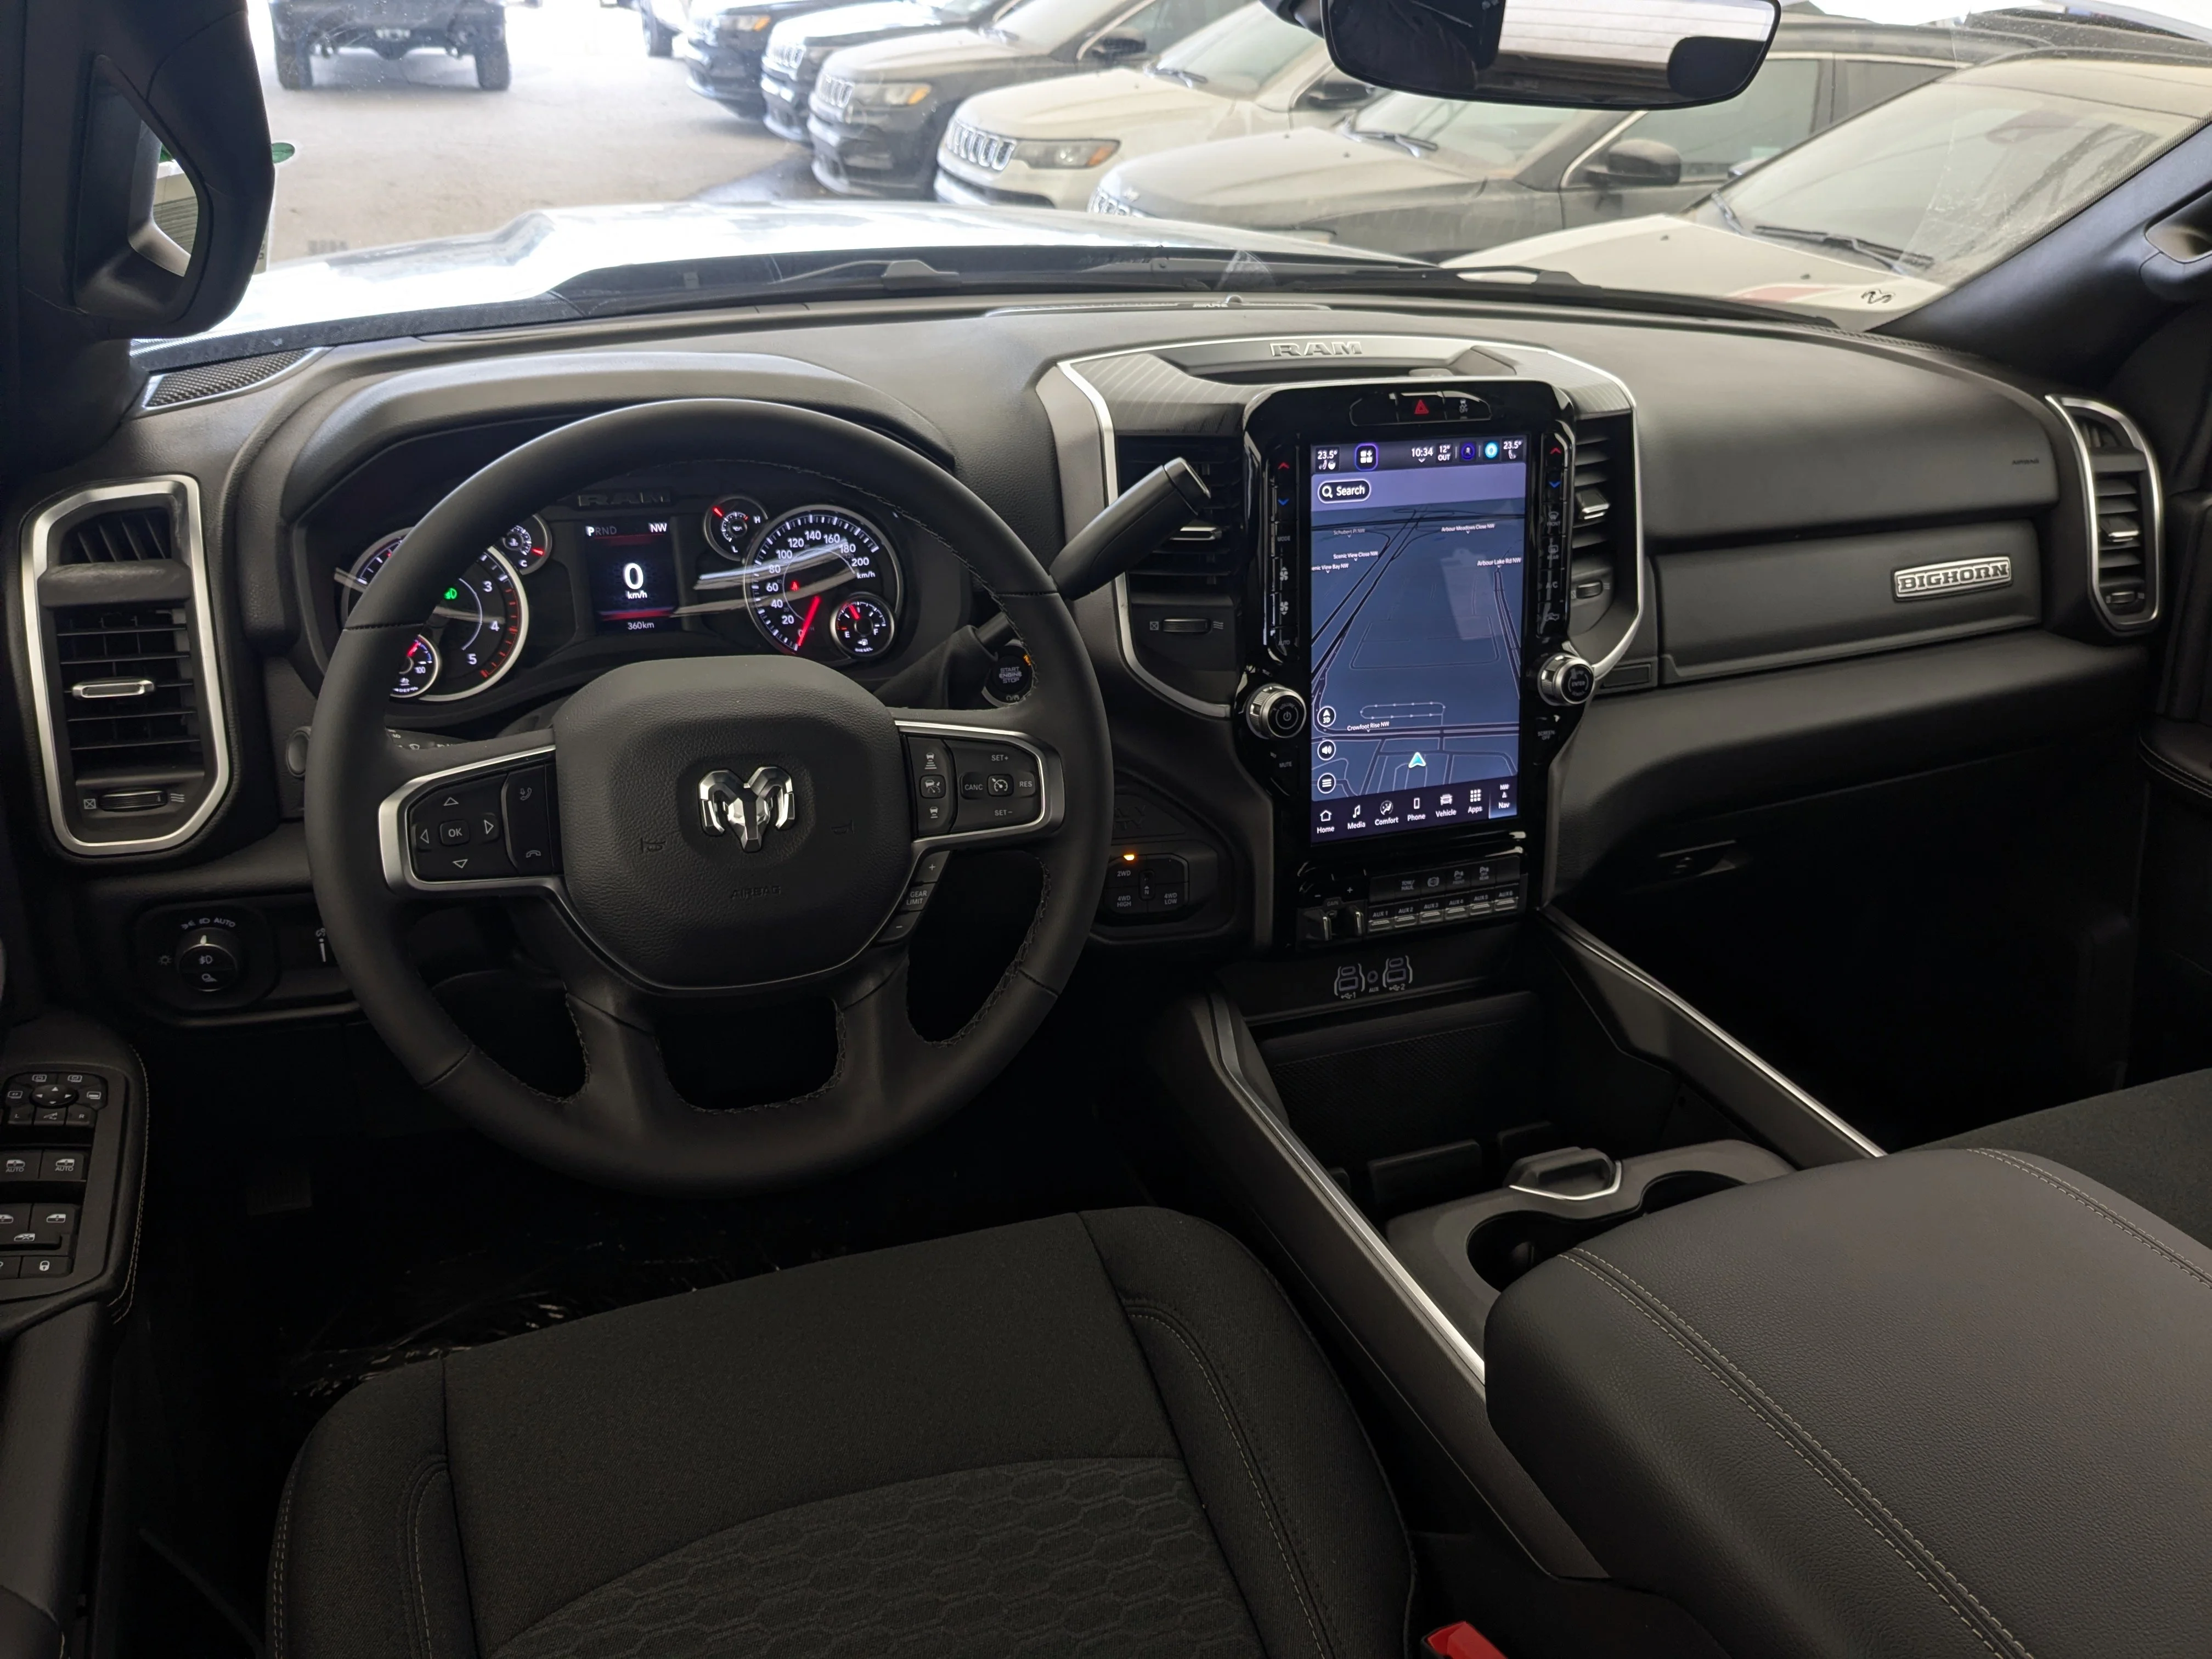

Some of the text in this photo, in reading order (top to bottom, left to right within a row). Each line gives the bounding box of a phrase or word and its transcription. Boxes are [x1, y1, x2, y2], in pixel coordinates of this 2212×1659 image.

[1270, 341, 1362, 357] RAM
[1440, 444, 1451, 453] 12°
[1503, 440, 1522, 450] 23.5°
[1317, 450, 1338, 460] 23.5°
[1411, 446, 1433, 457] 10:34
[1336, 485, 1365, 496] Search
[578, 492, 670, 506] RAM
[753, 515, 761, 524] H
[648, 522, 668, 533] NW
[804, 530, 821, 540] 140
[823, 534, 840, 544] 160
[787, 538, 804, 549] 120
[731, 545, 738, 553] L
[839, 544, 856, 554] 180
[776, 550, 792, 560] 100
[851, 556, 870, 567] 200
[769, 564, 781, 574] 80
[623, 562, 644, 590] 0
[856, 571, 876, 579] km/h
[483, 580, 493, 592] 3
[766, 583, 778, 592] 60
[627, 590, 647, 600] km/h
[770, 599, 783, 608] 40
[781, 615, 794, 625] 20
[490, 620, 500, 631] 4
[627, 621, 654, 631] 360km
[467, 653, 477, 665] 5
[1436, 809, 1457, 817] Vehicle
[1468, 806, 1483, 814] Apps
[1347, 821, 1366, 830] Media
[1375, 816, 1399, 826] Comfort
[448, 827, 463, 838] OK
[731, 885, 782, 900] AIRBAG
[213, 917, 236, 928] AUTO
